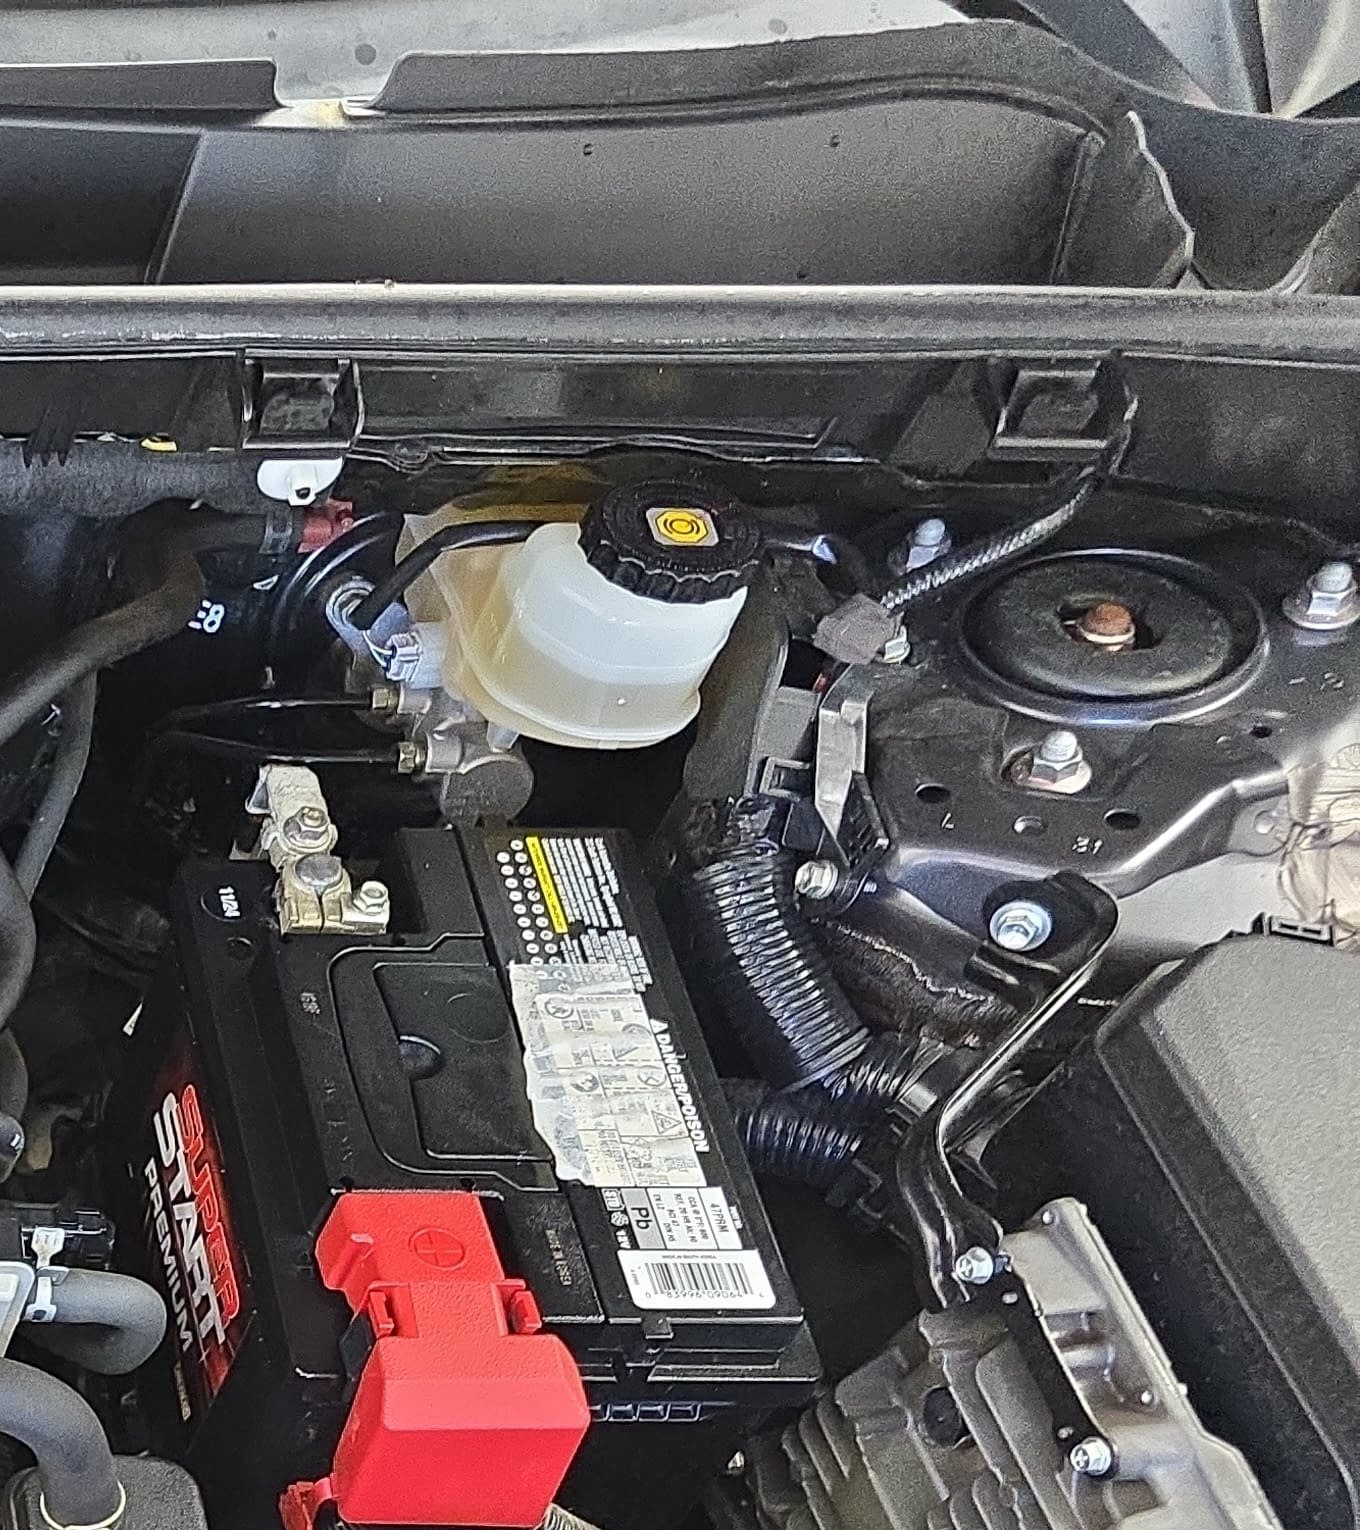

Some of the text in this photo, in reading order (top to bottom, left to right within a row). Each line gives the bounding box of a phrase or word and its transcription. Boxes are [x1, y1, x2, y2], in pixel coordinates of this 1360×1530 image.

[655, 1032, 710, 1153] DANGER/POISON
[144, 1156, 194, 1352] PREMIUM
[153, 1092, 226, 1345] START
[181, 1084, 239, 1330] SUPER
[615, 1229, 631, 1249] 12V
[630, 1207, 652, 1230] Pb
[710, 1203, 729, 1232] 47PRM
